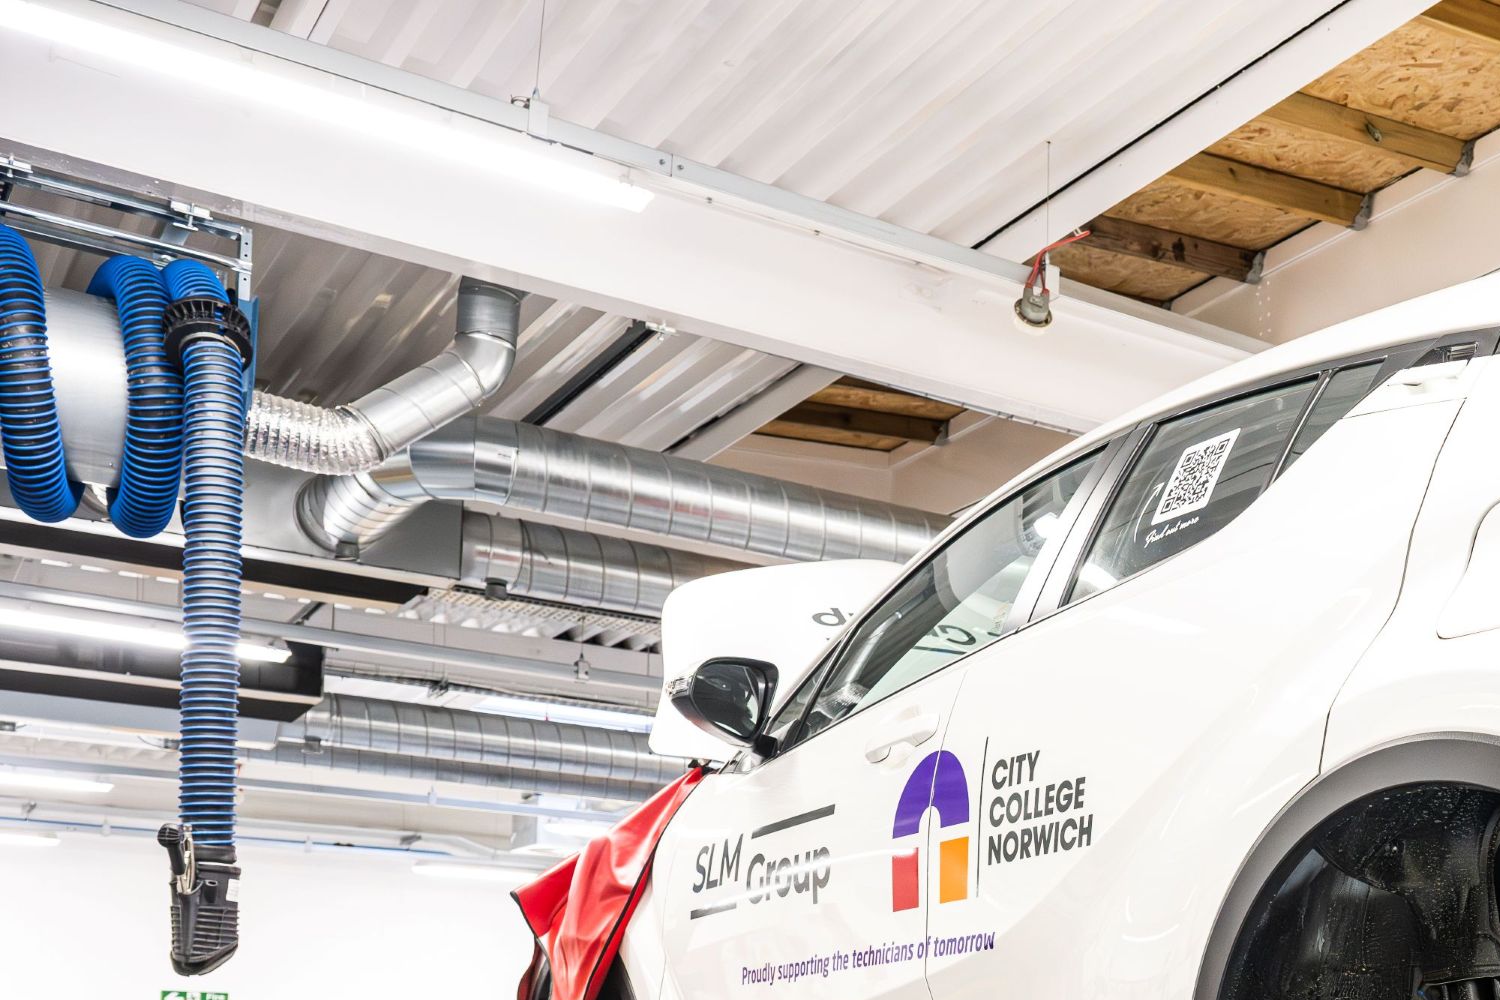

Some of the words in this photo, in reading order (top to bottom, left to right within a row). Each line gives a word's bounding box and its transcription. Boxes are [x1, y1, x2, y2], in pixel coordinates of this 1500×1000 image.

[991, 750, 1041, 790] CITY
[989, 776, 1086, 828] COLLEGE
[987, 813, 1094, 866] NORWICH
[692, 833, 744, 894] SLM
[746, 846, 831, 905] Group
[741, 963, 776, 987] Proudly
[777, 954, 830, 982] supporting
[832, 951, 849, 973] the
[851, 941, 914, 969] technicians
[916, 935, 932, 959] of
[933, 931, 996, 957] tomorrow
